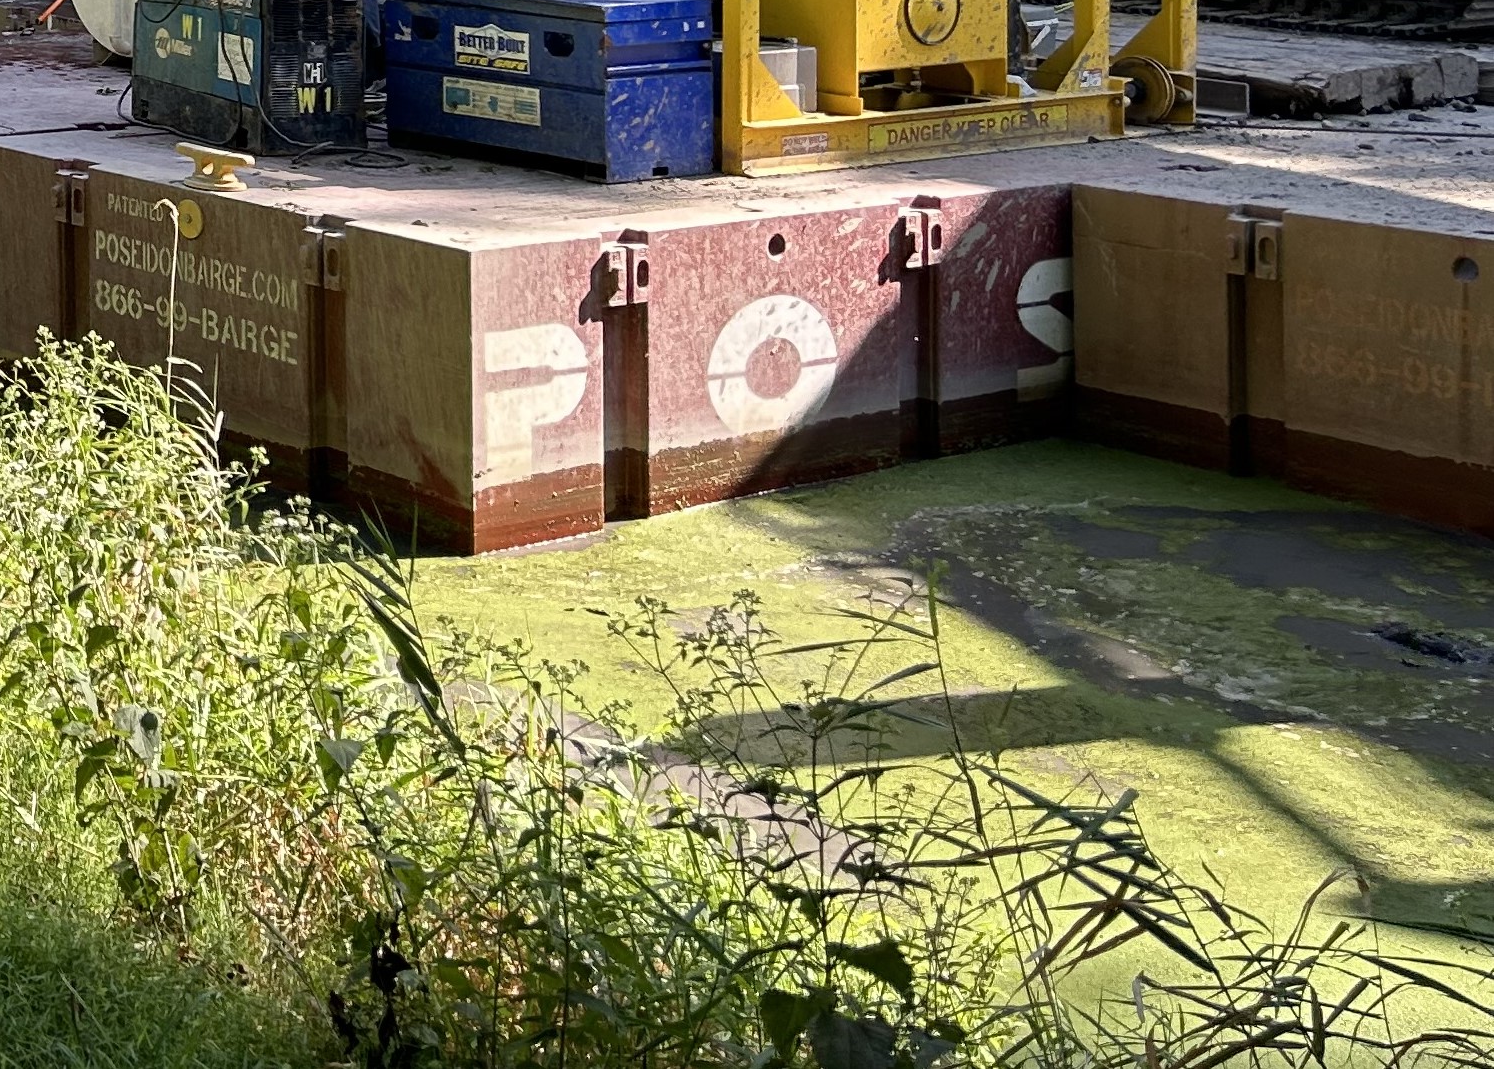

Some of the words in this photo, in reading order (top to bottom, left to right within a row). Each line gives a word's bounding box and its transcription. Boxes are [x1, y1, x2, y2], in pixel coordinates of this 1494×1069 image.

[458, 31, 496, 51] BETTER
[497, 35, 526, 54] BUILT
[887, 123, 952, 146] DANGER
[1000, 112, 1050, 134] CLER
[108, 193, 164, 222] PATENTED
[95, 229, 299, 313] POSEIDONBARGE.COM
[94, 279, 299, 366] 866-99-BARGE
